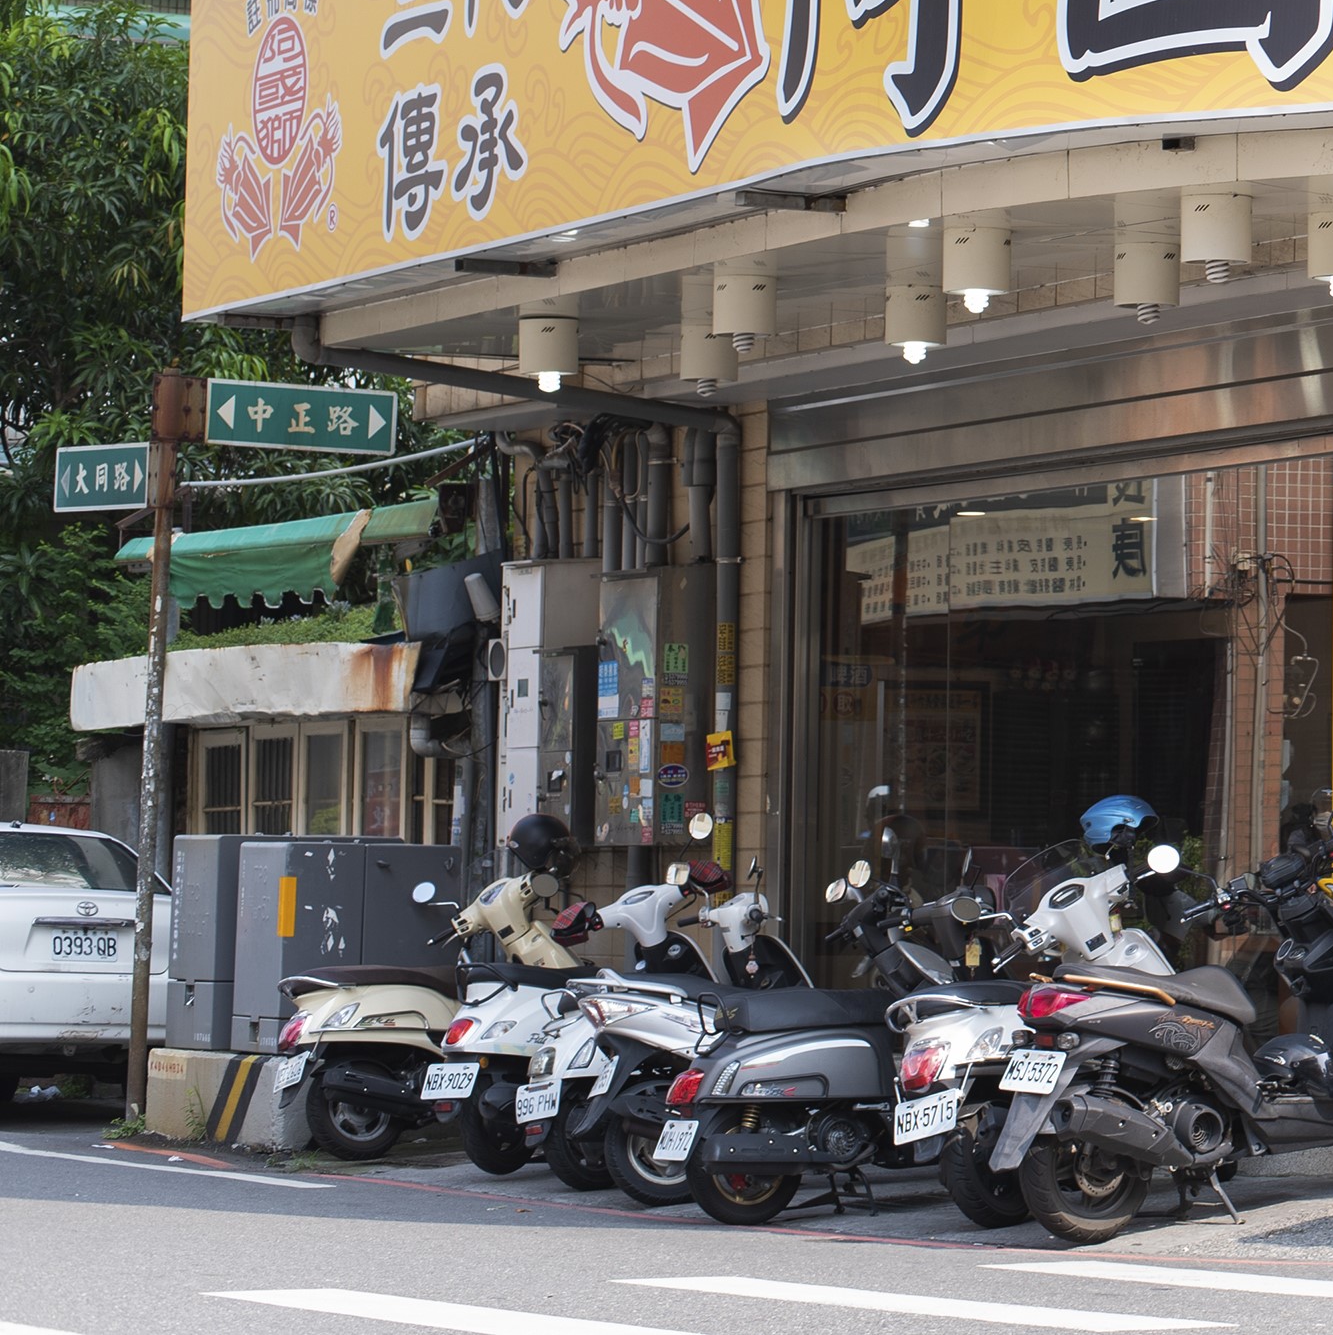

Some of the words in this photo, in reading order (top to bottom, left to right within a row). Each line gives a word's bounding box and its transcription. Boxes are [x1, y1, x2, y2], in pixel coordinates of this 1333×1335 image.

[377, 63, 528, 241] 傳承
[246, 395, 360, 437] 中正路
[74, 461, 130, 494] 大同路
